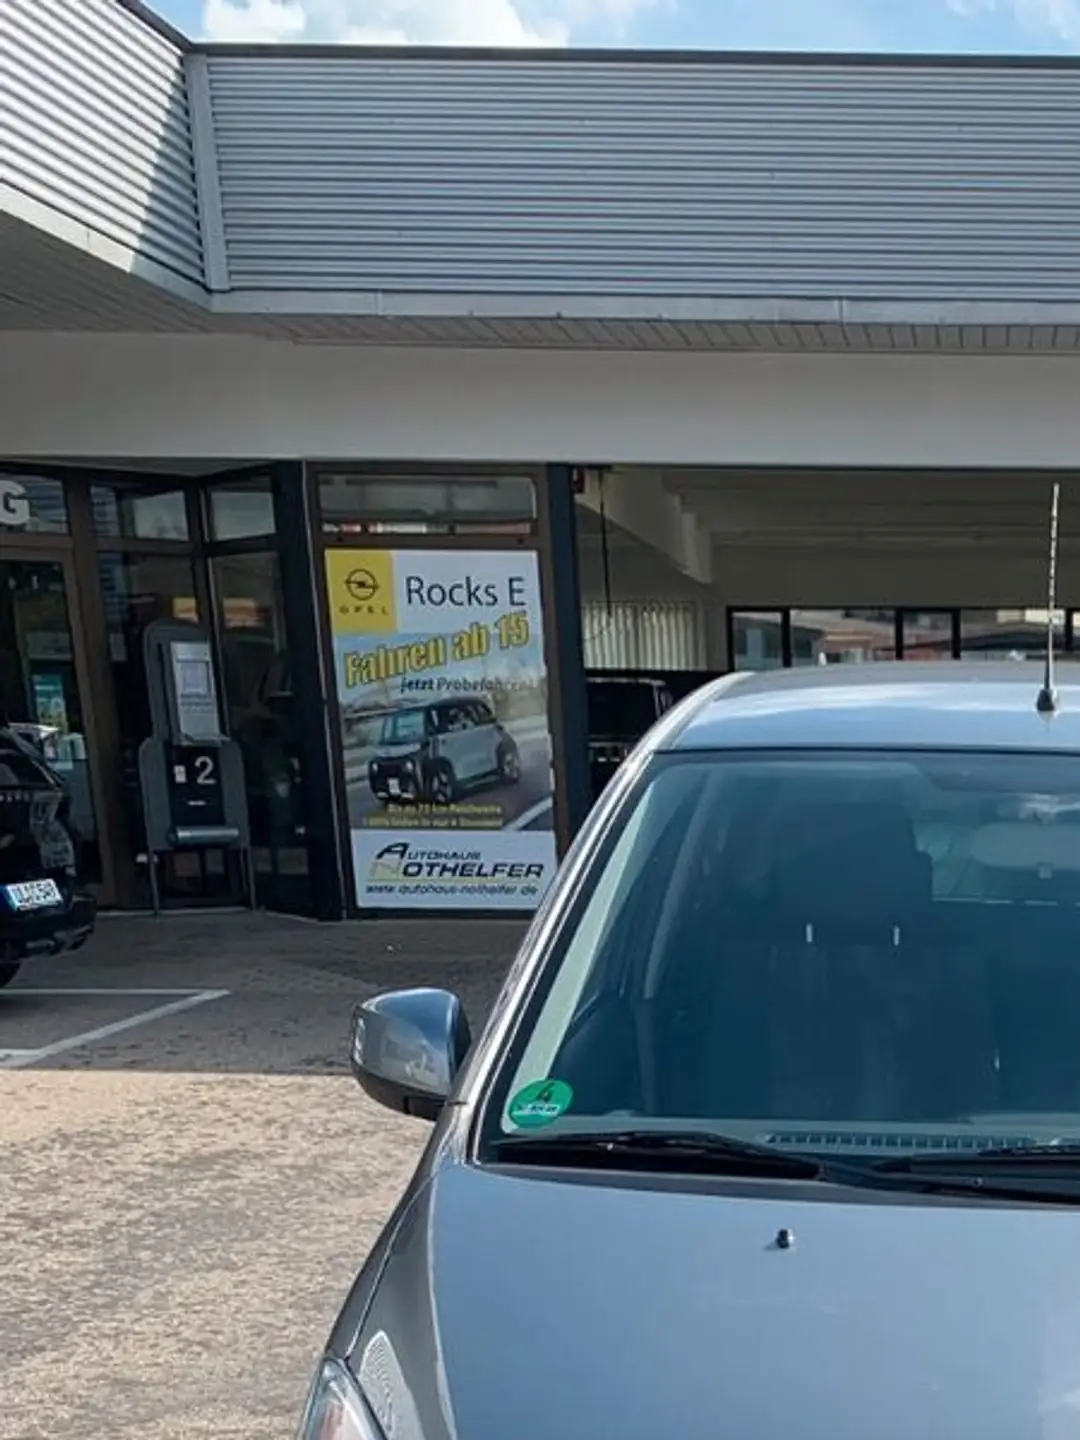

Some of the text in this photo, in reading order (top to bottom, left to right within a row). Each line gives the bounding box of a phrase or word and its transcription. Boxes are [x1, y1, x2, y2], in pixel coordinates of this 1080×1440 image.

[406, 576, 527, 606] Rocks E
[339, 605, 388, 615] OPEL
[345, 611, 530, 688] Fahren ab 15
[195, 756, 216, 784] 2
